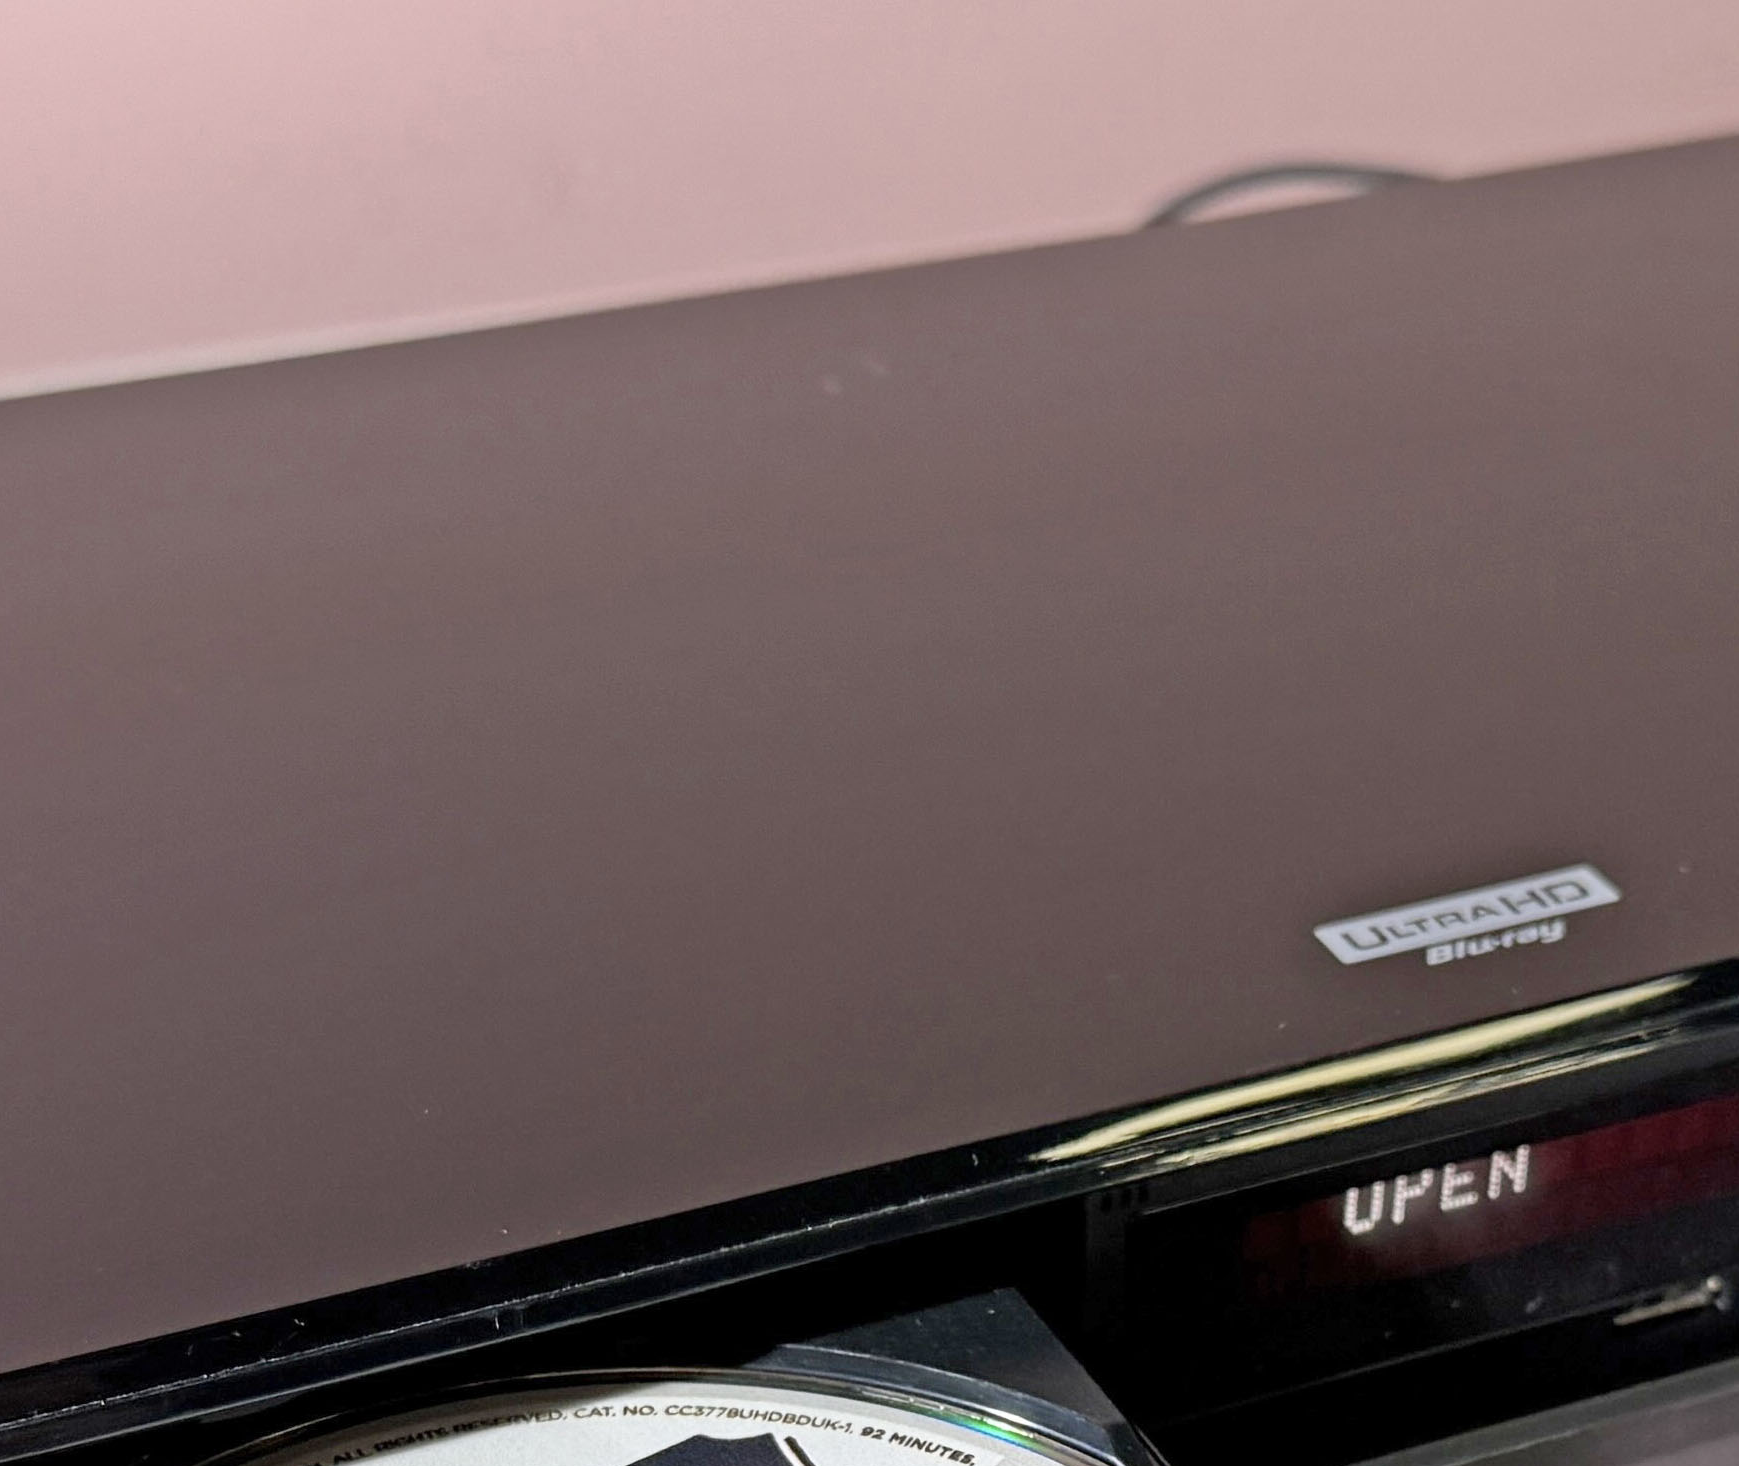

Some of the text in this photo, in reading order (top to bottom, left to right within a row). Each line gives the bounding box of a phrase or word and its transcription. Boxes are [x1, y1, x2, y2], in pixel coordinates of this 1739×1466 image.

[1425, 918, 1567, 966] Blu-ray
[622, 1404, 658, 1418] NO.
[859, 1425, 886, 1440] 92
[888, 1432, 976, 1466] MINUTES.
